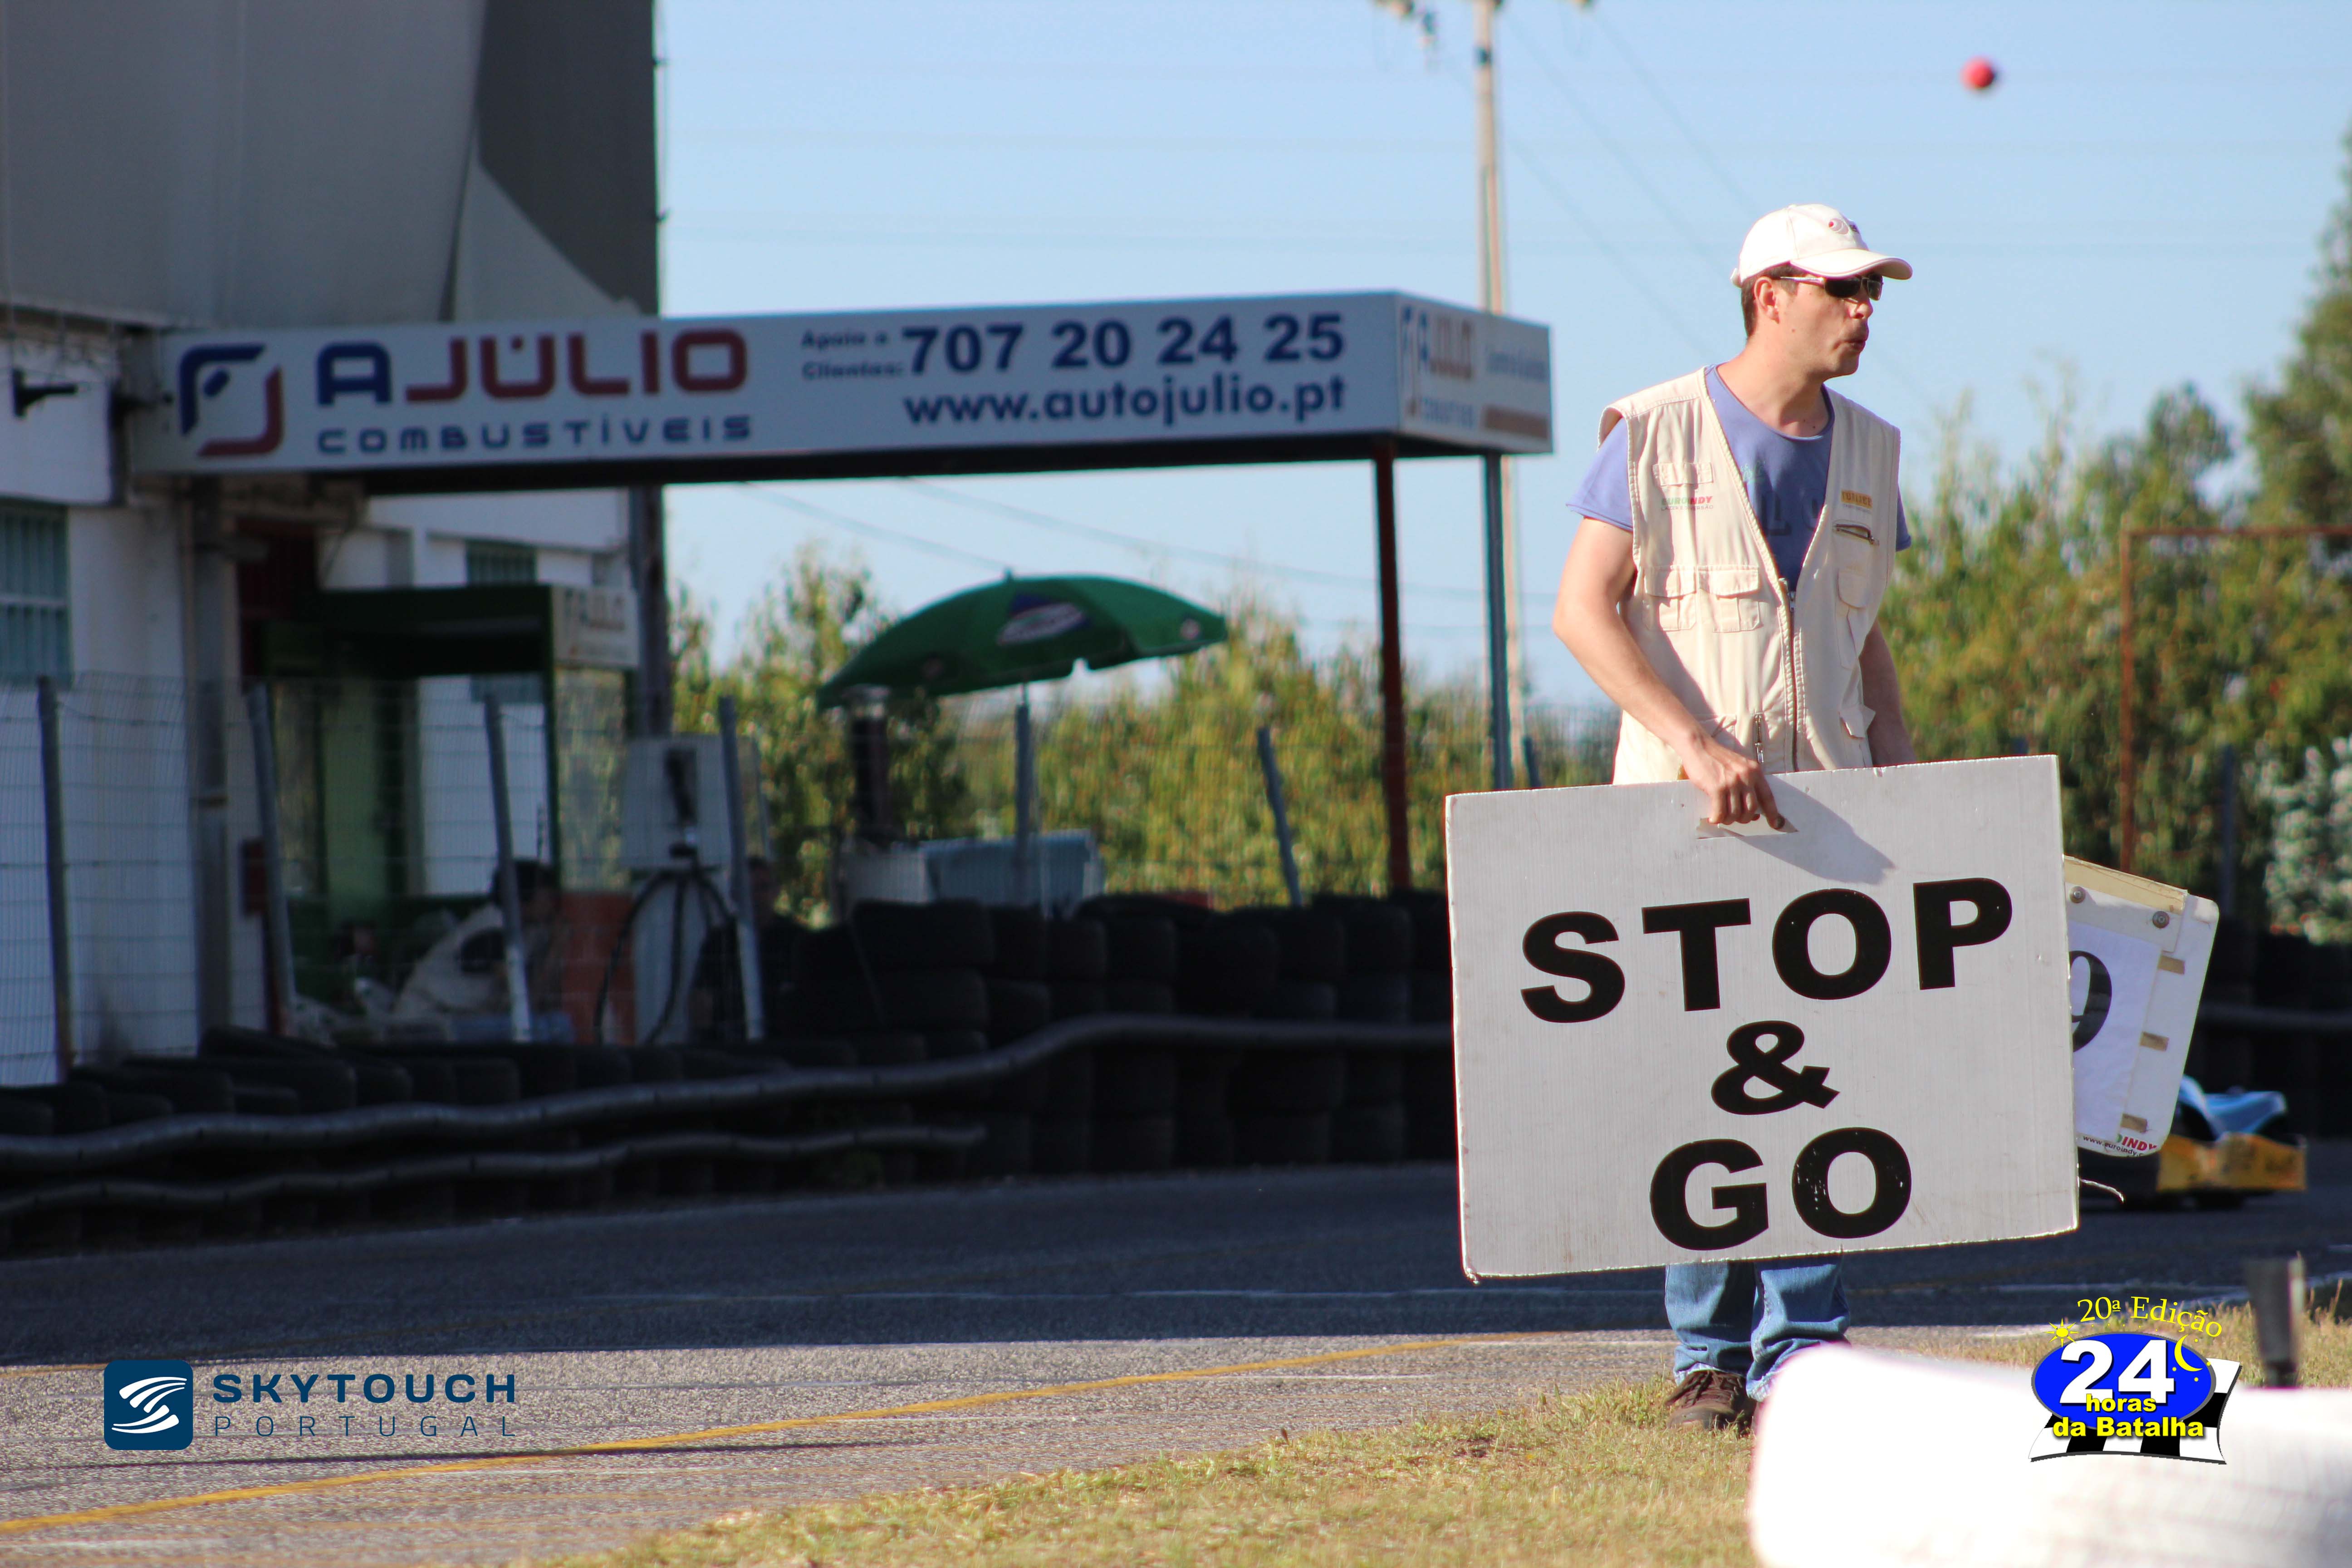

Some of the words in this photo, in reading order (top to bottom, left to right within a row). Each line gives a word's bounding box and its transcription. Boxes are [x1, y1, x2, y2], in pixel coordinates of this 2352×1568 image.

[902, 323, 1024, 374] 707
[1051, 319, 1131, 369] 20
[1156, 315, 1238, 364] 24
[1263, 313, 1344, 362] 25
[317, 413, 752, 454] COMBUSTÍVEIS
[903, 372, 1346, 426] www.autojulio.pt
[1520, 877, 2012, 1023] STOP
[1711, 1020, 1840, 1115] &
[1650, 1127, 1912, 1250] GO
